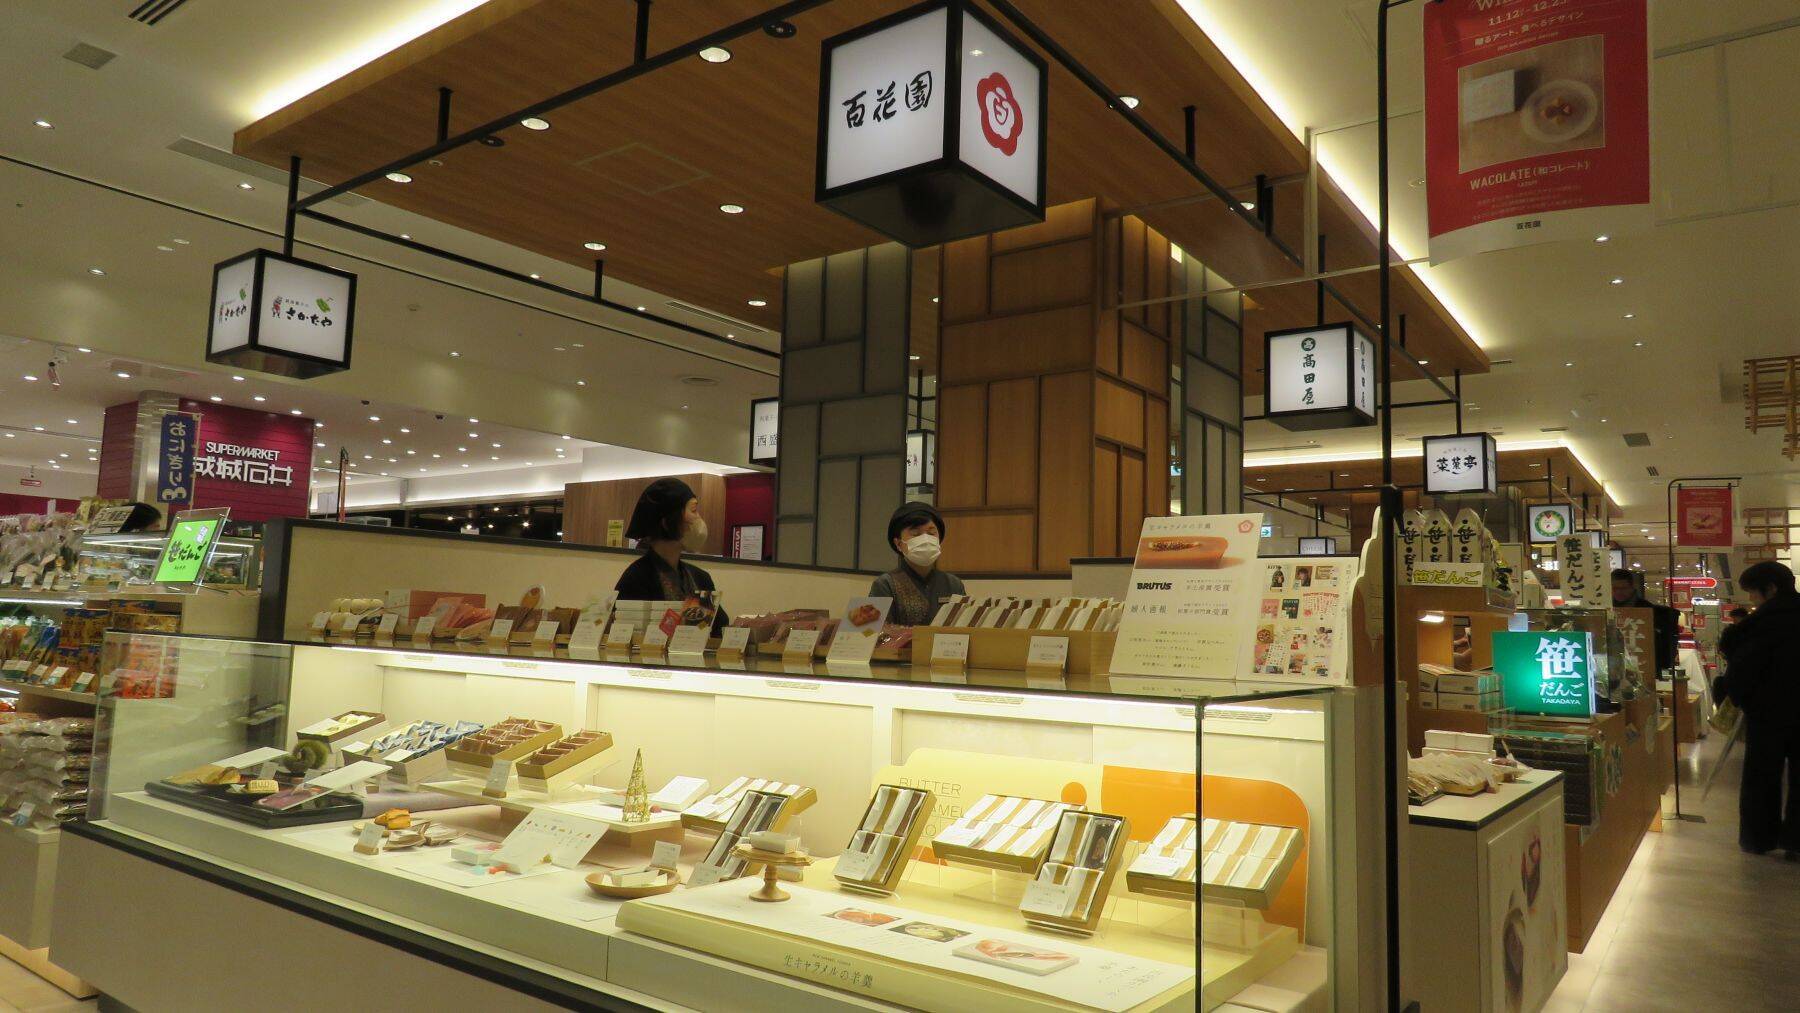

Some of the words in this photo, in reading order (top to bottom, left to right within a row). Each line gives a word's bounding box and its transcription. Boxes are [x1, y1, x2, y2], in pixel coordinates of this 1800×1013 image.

[206, 441, 281, 461] SUPERMARKET
[193, 455, 294, 487] 成城石井
[1136, 582, 1173, 591] BRUTUS
[1535, 637, 1584, 679] 笹
[1539, 681, 1585, 697] だんご
